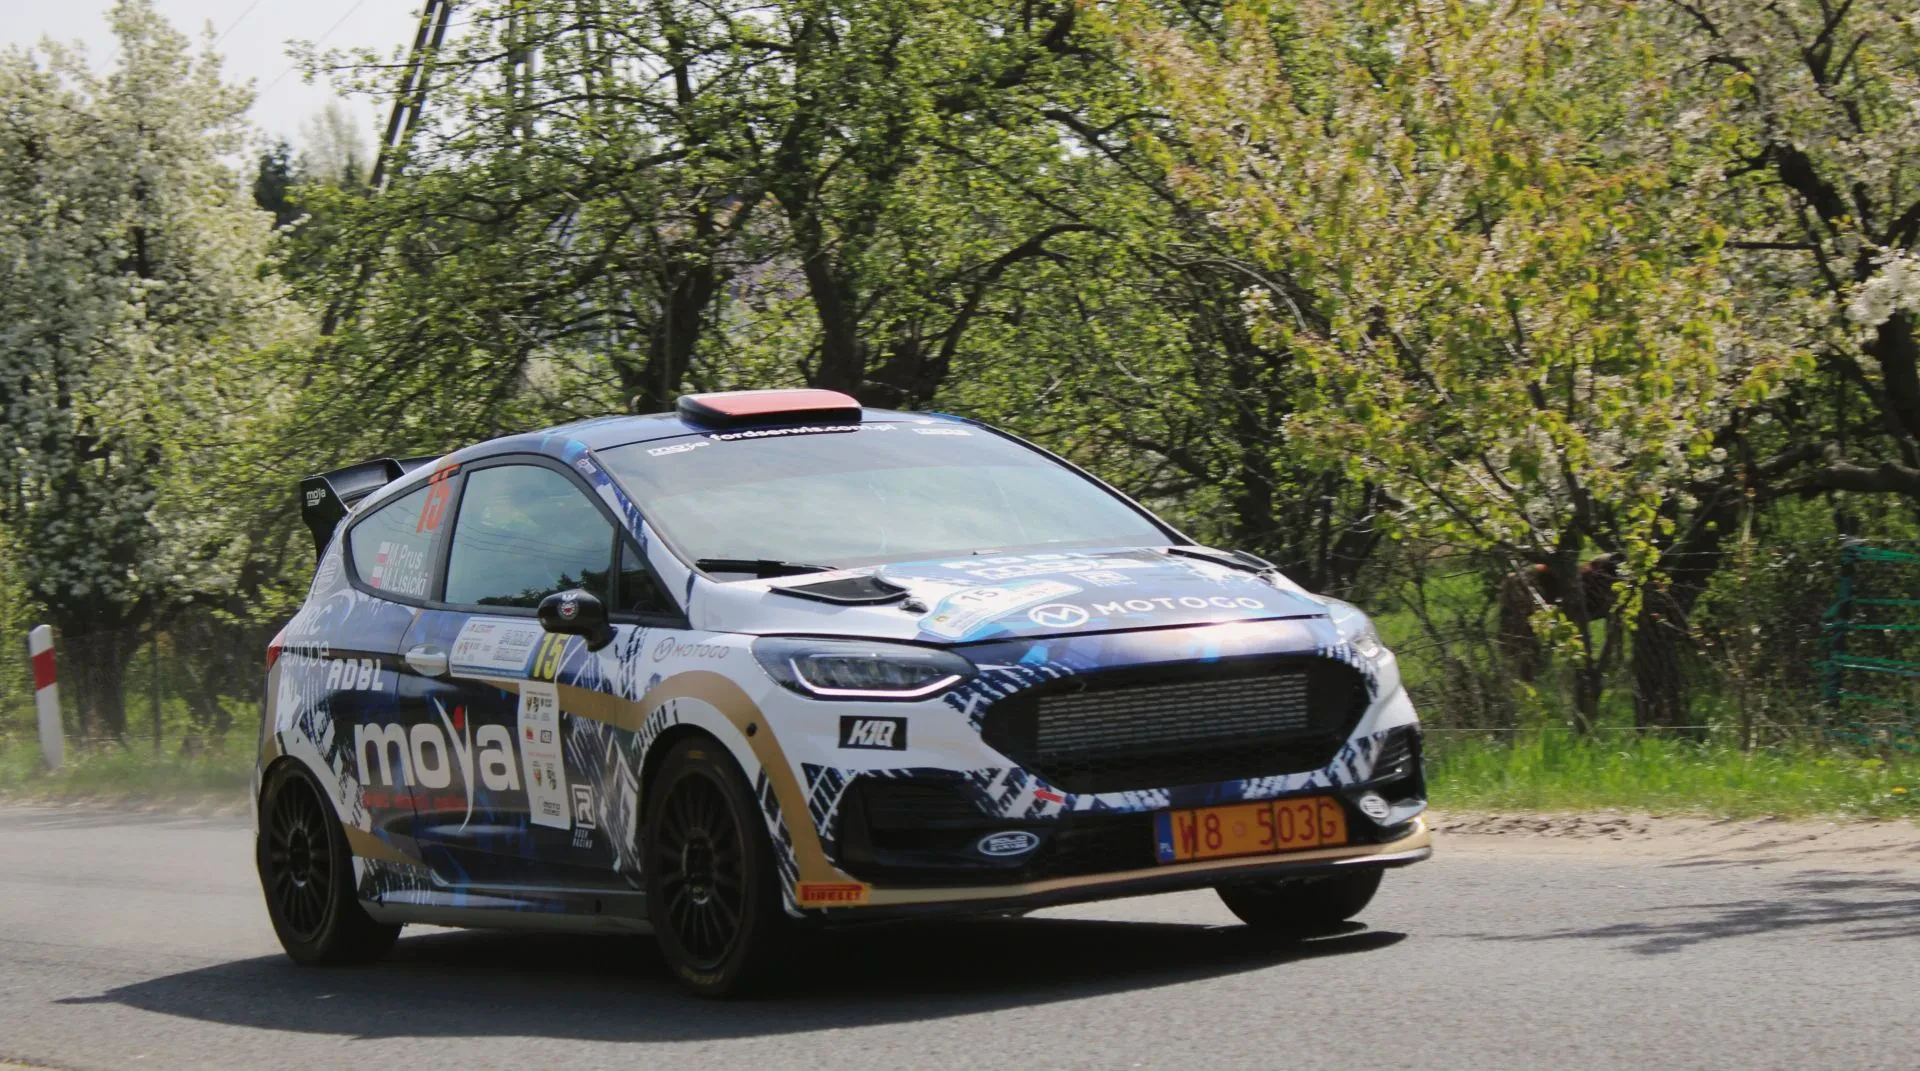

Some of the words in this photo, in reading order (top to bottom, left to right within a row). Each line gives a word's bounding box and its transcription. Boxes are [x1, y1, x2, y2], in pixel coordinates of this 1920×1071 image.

[416, 464, 460, 533] 15
[385, 543, 423, 570] M.Prus
[961, 589, 998, 602] 15
[1091, 596, 1265, 615] MOTOGO
[534, 633, 569, 680] 15
[672, 643, 730, 659] MOTOGO
[326, 658, 384, 691] ADBL
[354, 697, 521, 832] moya
[1178, 812, 1223, 854] W8
[1255, 802, 1338, 846] 503G
